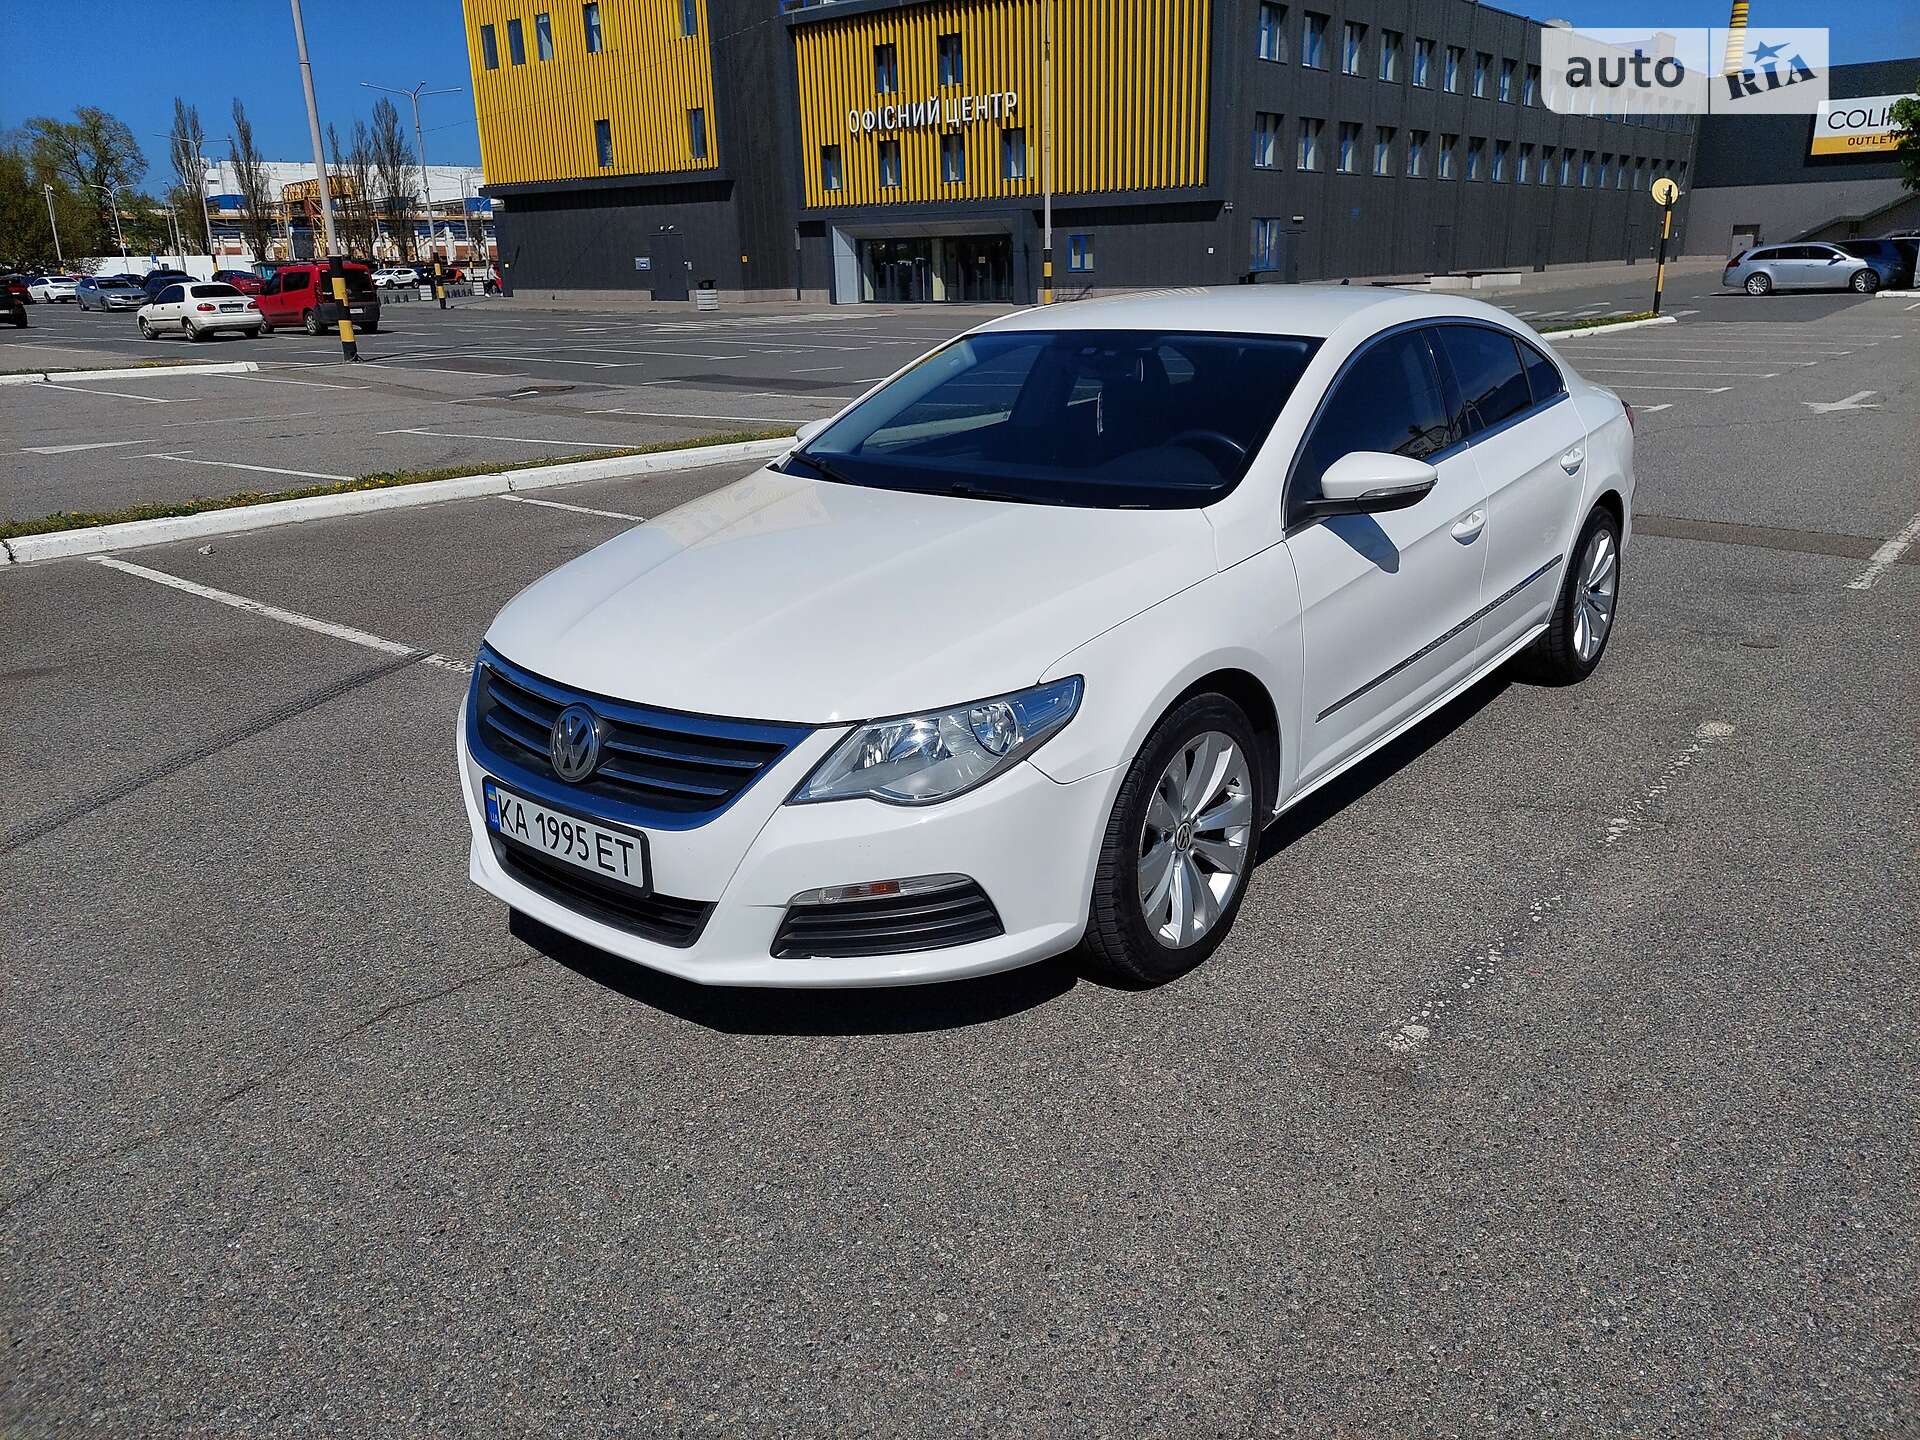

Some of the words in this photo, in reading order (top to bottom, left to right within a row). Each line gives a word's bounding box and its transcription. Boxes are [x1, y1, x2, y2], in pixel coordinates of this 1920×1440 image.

[849, 96, 940, 133] ОФІСНИЙ
[945, 91, 1017, 128] ЦЕНТР
[498, 794, 530, 840] KA
[535, 812, 590, 862] 1995
[595, 831, 634, 877] ET
